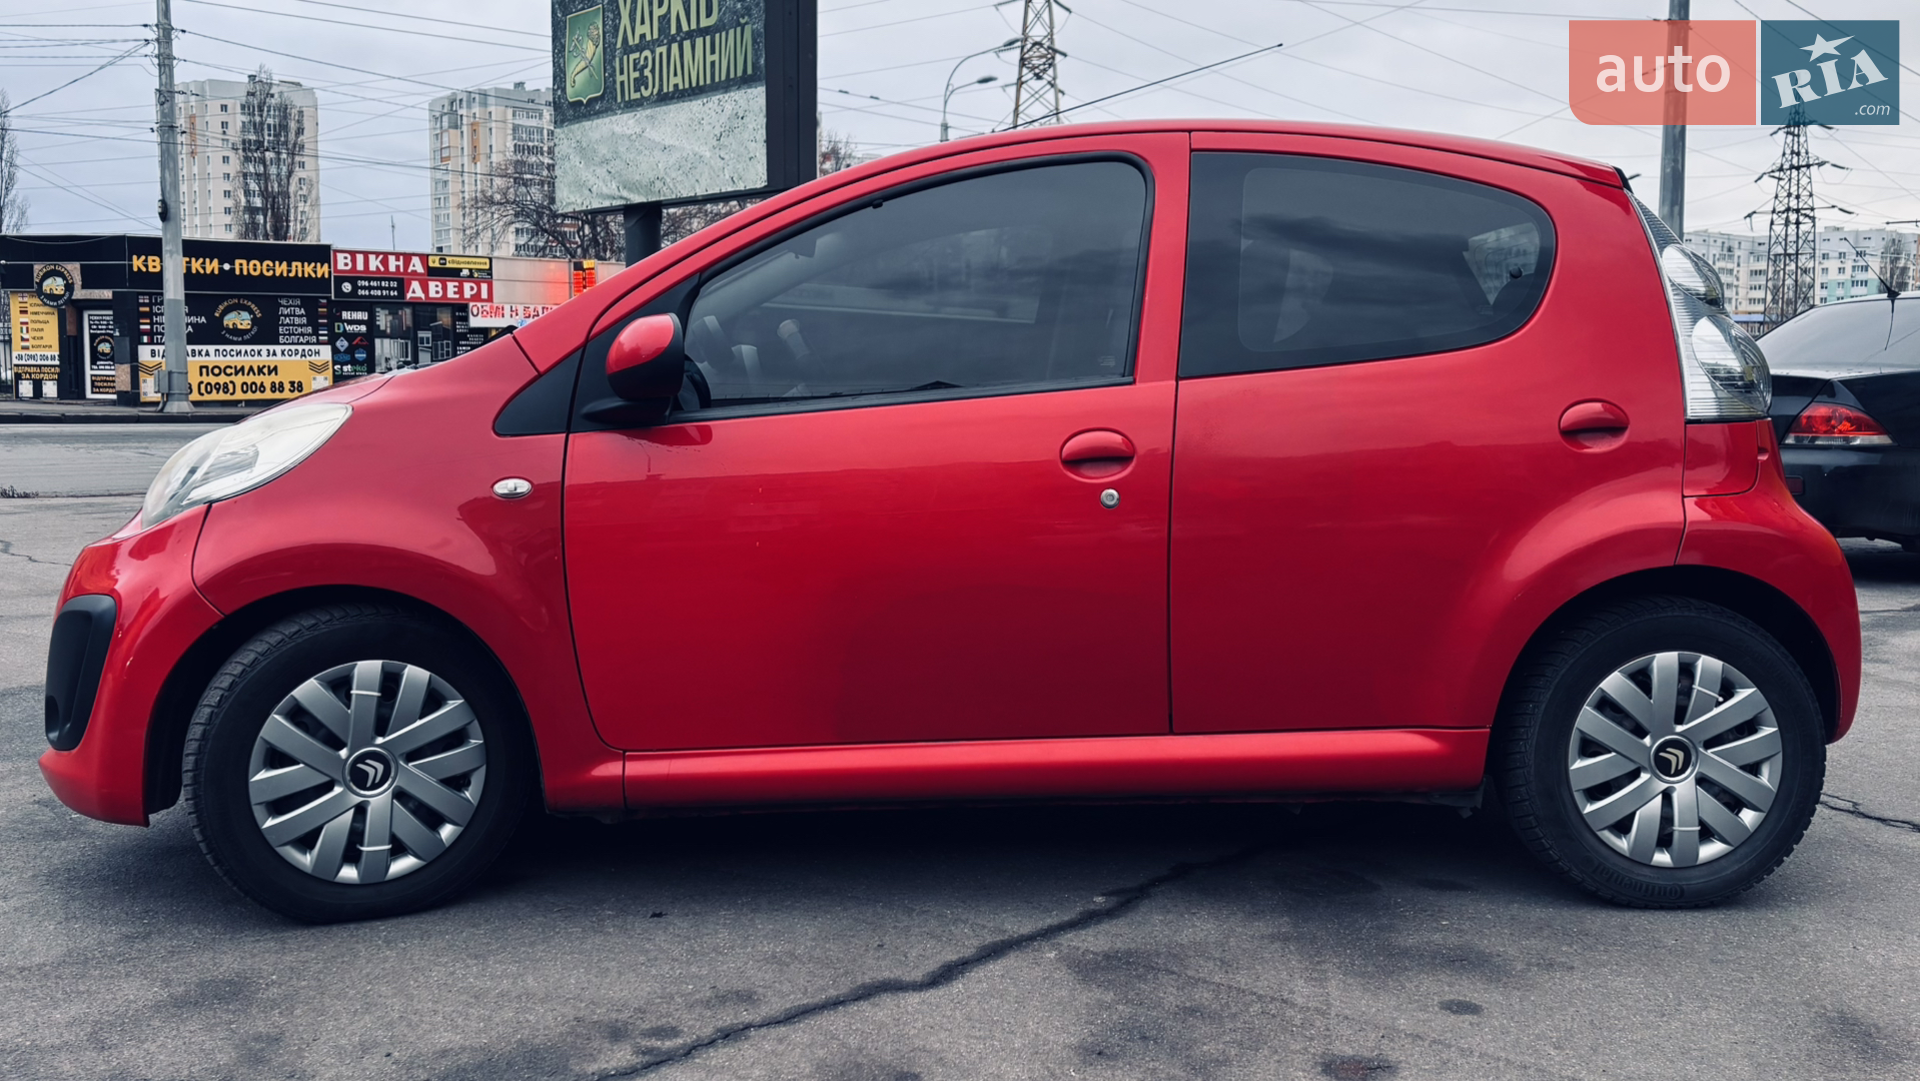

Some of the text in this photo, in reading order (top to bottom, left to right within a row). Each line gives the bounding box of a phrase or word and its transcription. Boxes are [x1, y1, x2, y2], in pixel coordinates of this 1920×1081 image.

[616, 16, 752, 103] НЕЗЛАМНИЙ
[132, 254, 329, 278] КВТКИ ПОСИЛКИ
[336, 252, 425, 274] ВІКНА
[406, 280, 489, 300] ДВЕРІ
[278, 298, 301, 306] ЧЕХІЯ
[278, 307, 306, 316] ЛИТВА
[341, 310, 368, 320] REHAU
[279, 316, 307, 325] ЛАТВІЯ
[279, 326, 312, 334] ЕСТОНІЯ
[279, 335, 317, 344] БОЛГАРІЯ
[214, 348, 263, 358] ПОСИЛОК
[266, 348, 277, 358] ЗА
[280, 348, 320, 359] КОРДОН
[199, 364, 278, 377] ПОСИЛКИ
[197, 380, 236, 396] (098)
[241, 380, 266, 394] 006
[270, 380, 285, 394] 88
[288, 380, 304, 393] 38
